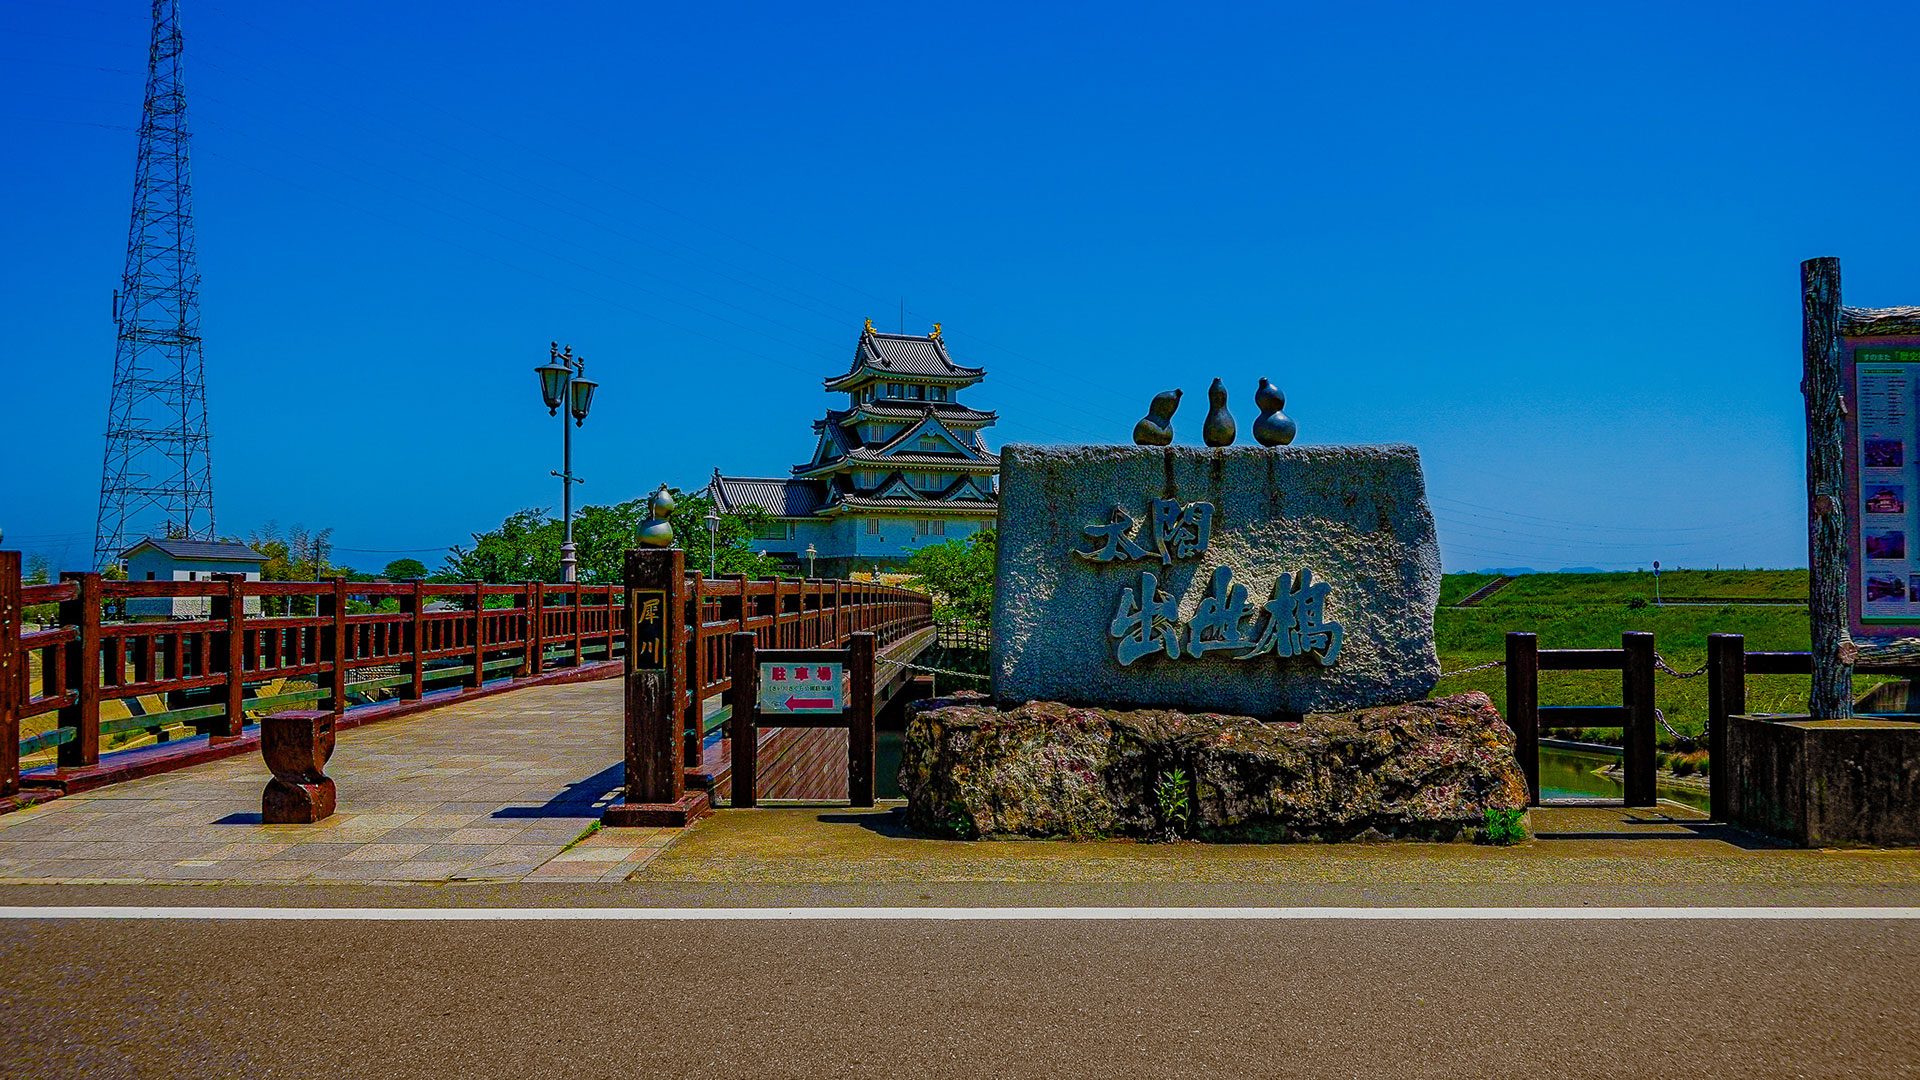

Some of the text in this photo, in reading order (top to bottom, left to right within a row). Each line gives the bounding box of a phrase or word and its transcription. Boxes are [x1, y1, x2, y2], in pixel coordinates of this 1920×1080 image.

[1073, 498, 1215, 565] 太閤
[638, 598, 660, 664] 犀川
[1111, 565, 1343, 666] 出世橋
[772, 666, 832, 681] 駐車場
